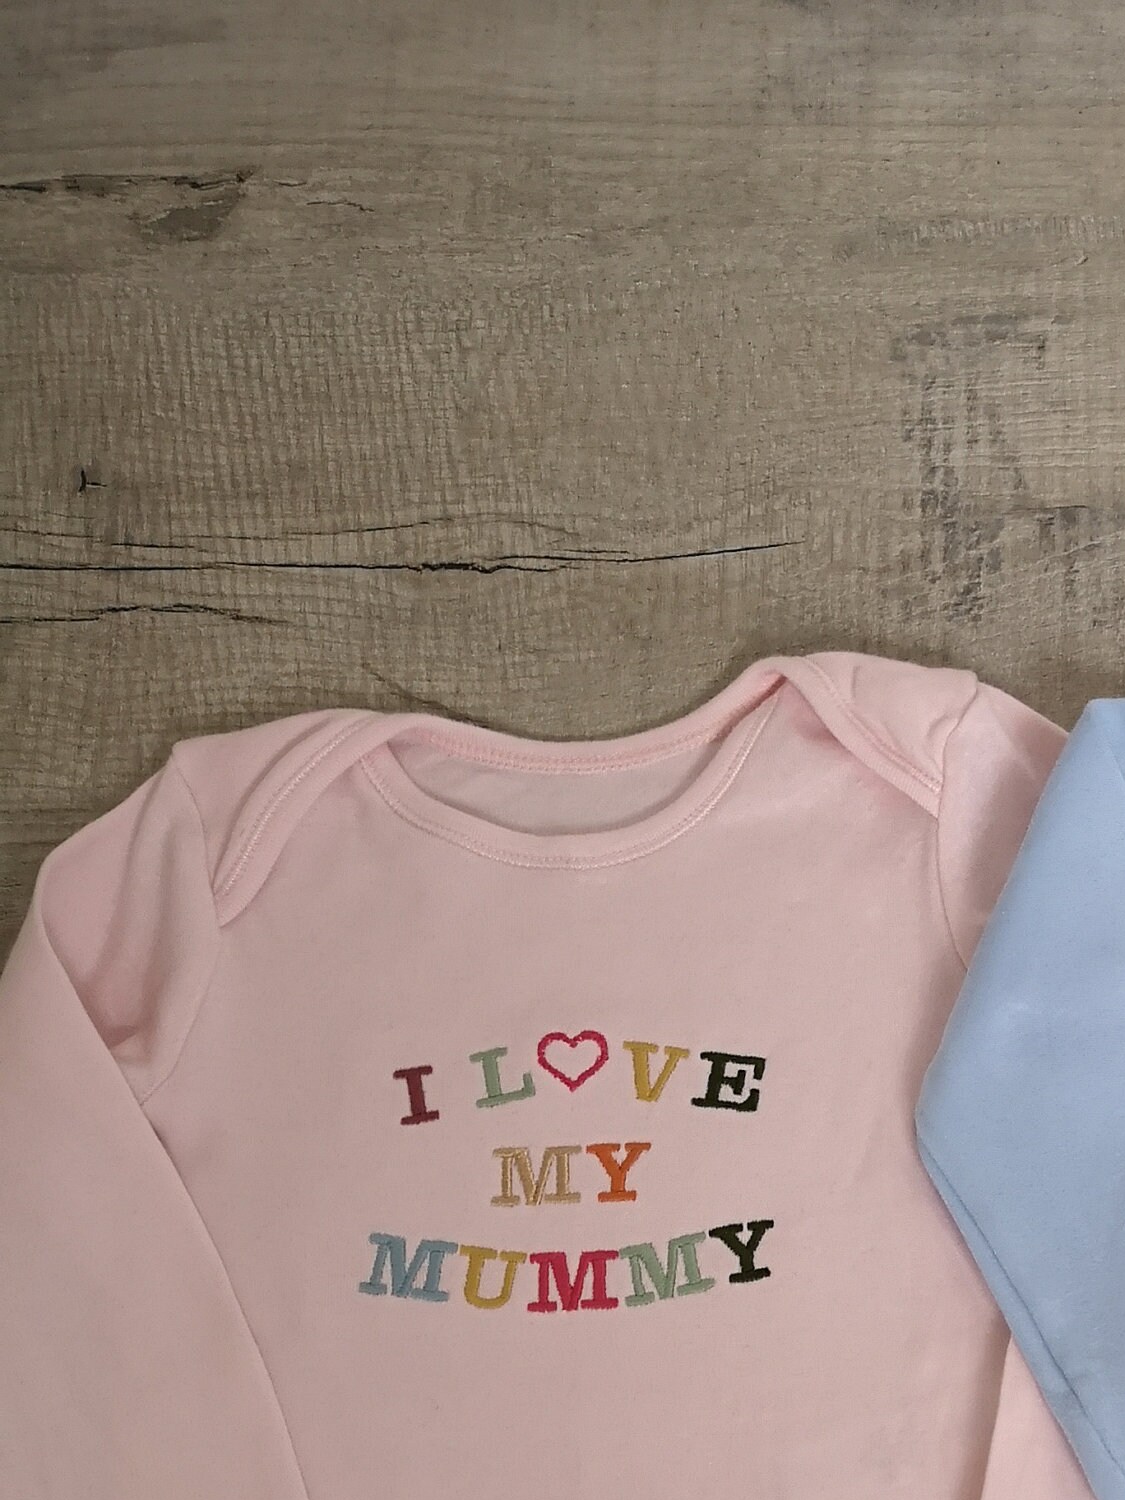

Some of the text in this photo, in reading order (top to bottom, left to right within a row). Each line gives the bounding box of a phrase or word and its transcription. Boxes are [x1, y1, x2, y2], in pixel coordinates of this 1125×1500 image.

[393, 1065, 439, 1125] I
[490, 1142, 652, 1207] MY
[358, 1219, 775, 1312] MUMMY
